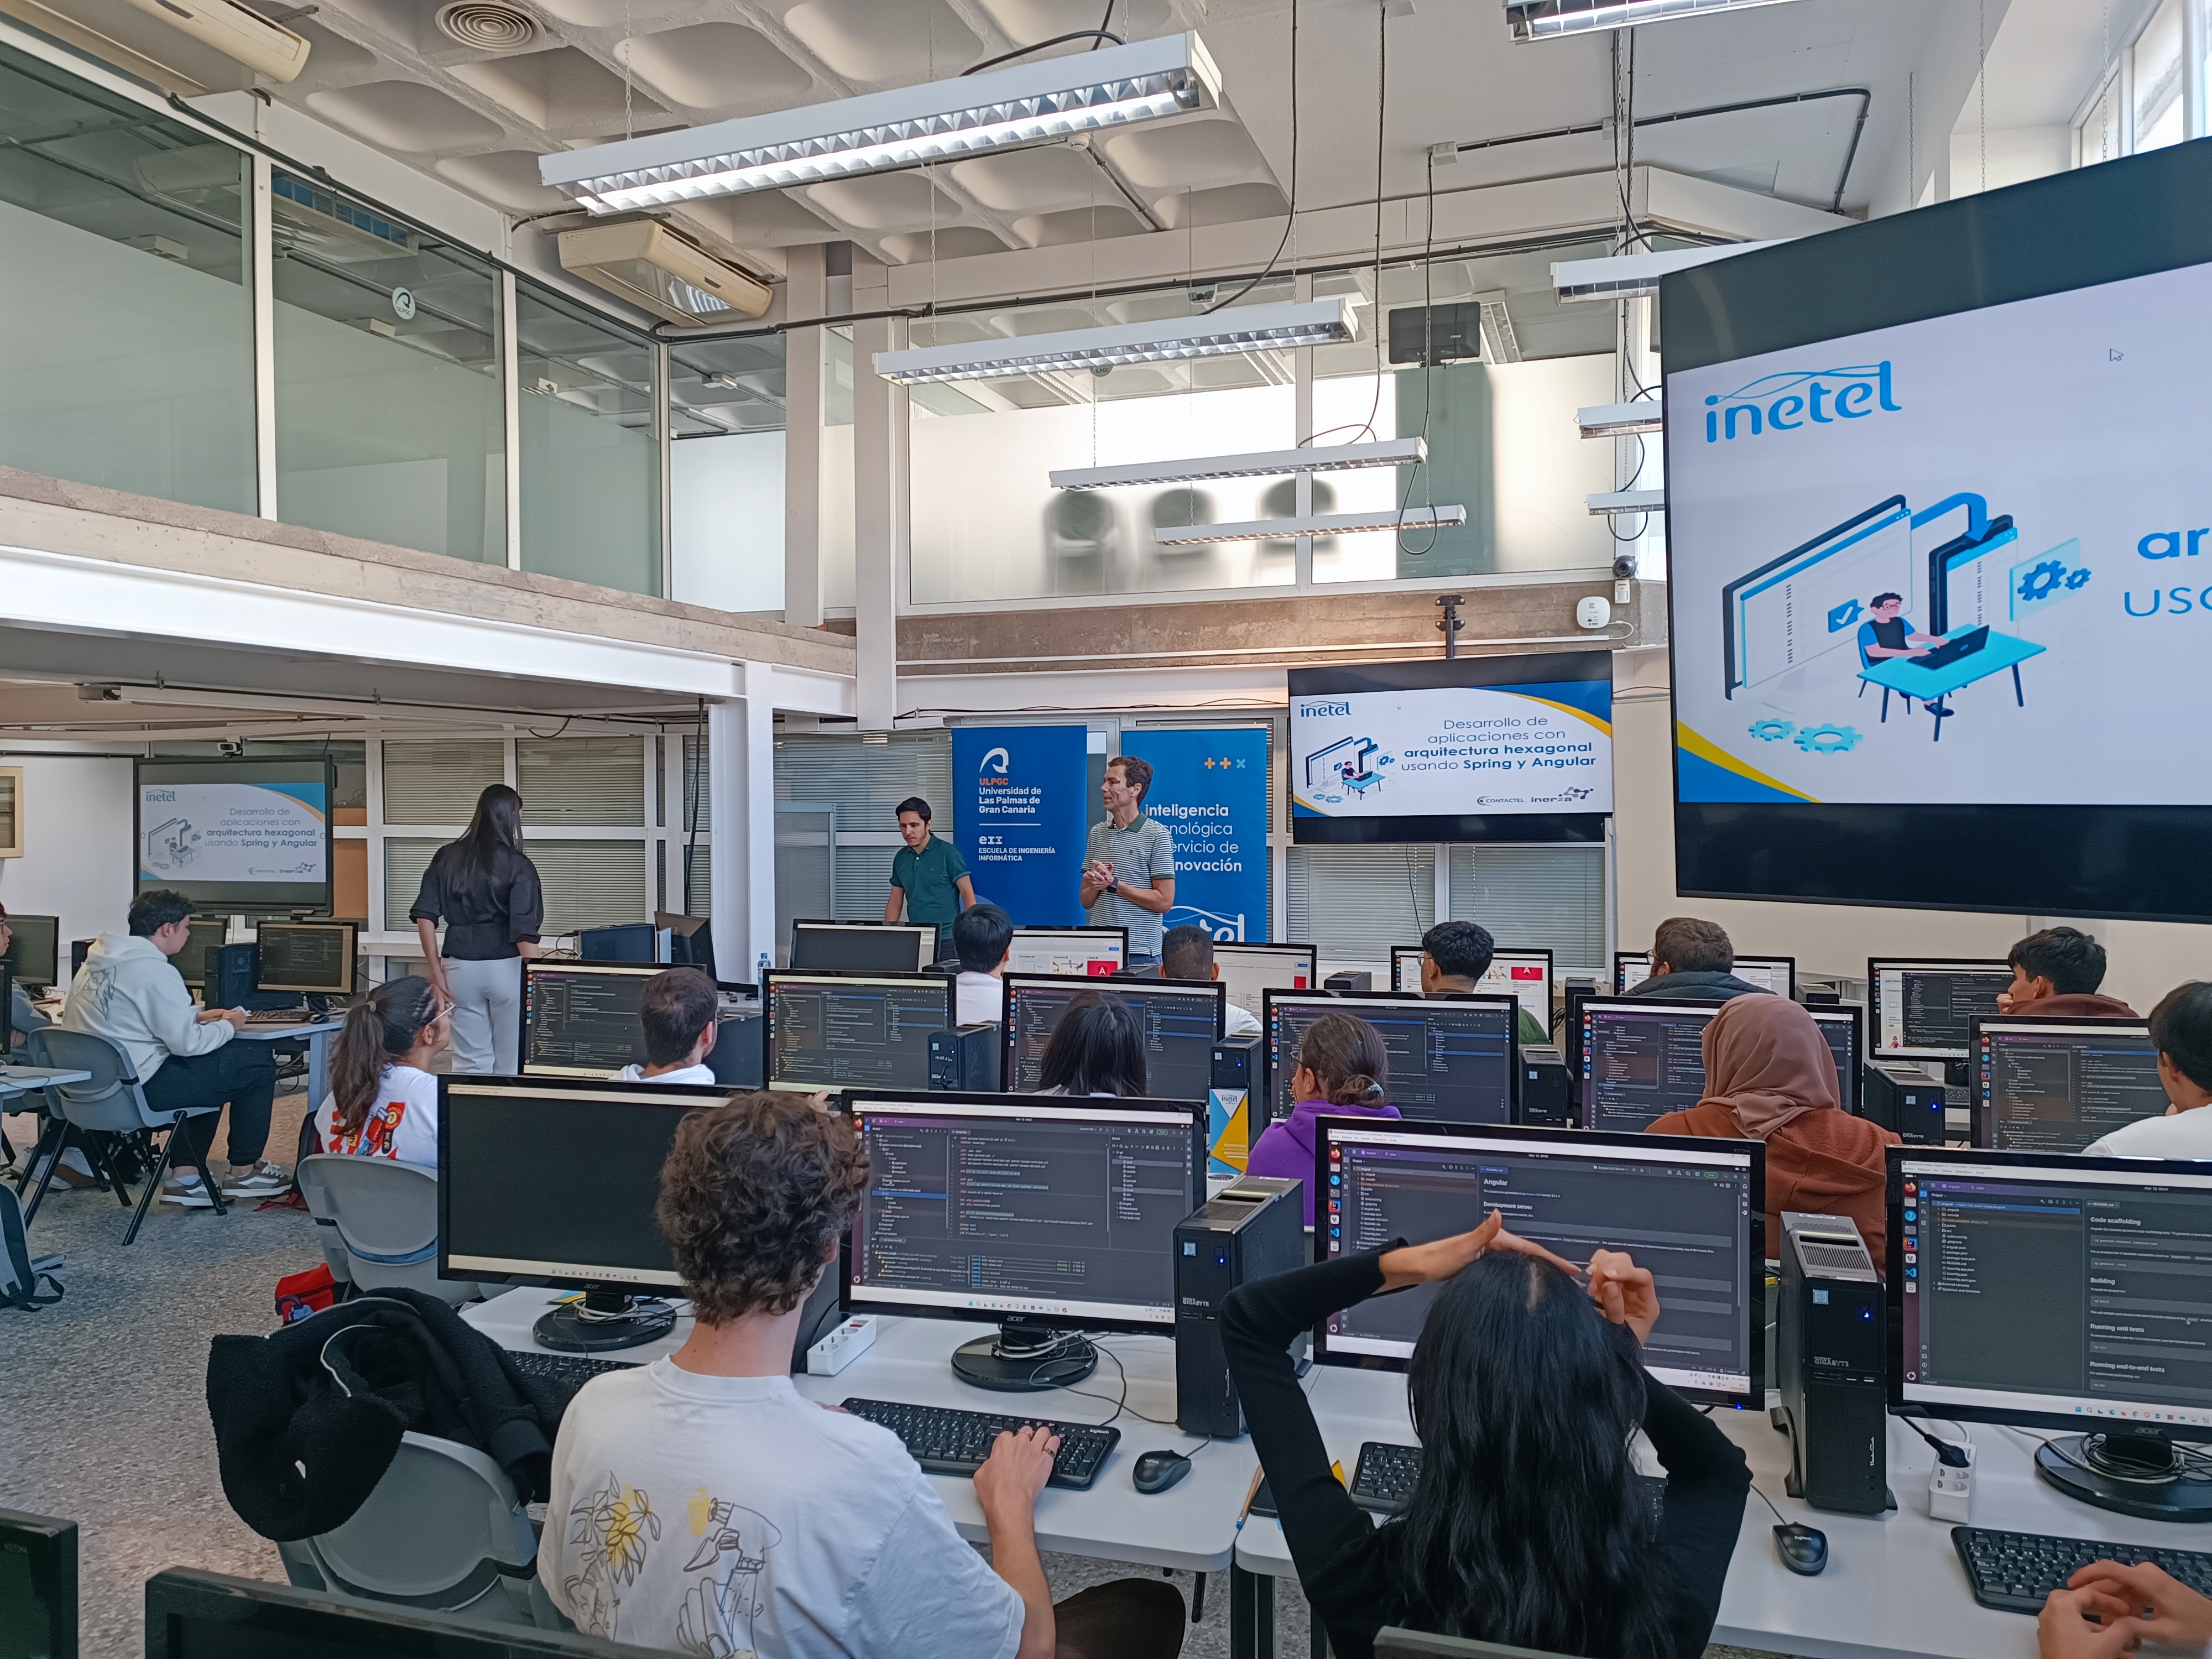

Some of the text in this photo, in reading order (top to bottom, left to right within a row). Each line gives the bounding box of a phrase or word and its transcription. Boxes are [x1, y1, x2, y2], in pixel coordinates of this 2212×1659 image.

[1704, 360, 1902, 444] inetel
[1301, 701, 1352, 717] inetel
[1444, 716, 1548, 730] Desarrollo de
[1428, 729, 1566, 744] aplicaciones con
[1404, 743, 1592, 759] arquitectura hexagonal
[1401, 757, 1596, 771] usando Spring y Angular
[979, 786, 1041, 795] Universidad de
[146, 790, 176, 802] inetel
[1145, 804, 1229, 819] inteligencia
[220, 818, 279, 827] aplicaciones
[206, 829, 315, 838] arquitectura hexagonal
[241, 839, 269, 848] Spring
[280, 839, 317, 848] Angular
[1171, 840, 1239, 853] ervicio de
[1175, 858, 1242, 872] novación
[1222, 1094, 1238, 1103] inetel
[1483, 1201, 1516, 1209] Development
[2107, 1218, 2141, 1227] scaffolding
[2090, 1277, 2116, 1286] Building
[1182, 1297, 1209, 1307] GIGABYTE
[2090, 1323, 2115, 1332] Running
[1814, 1357, 1849, 1367] GIGABYTE
[2090, 1361, 2115, 1369] Running
[2135, 1426, 2163, 1434] acer
